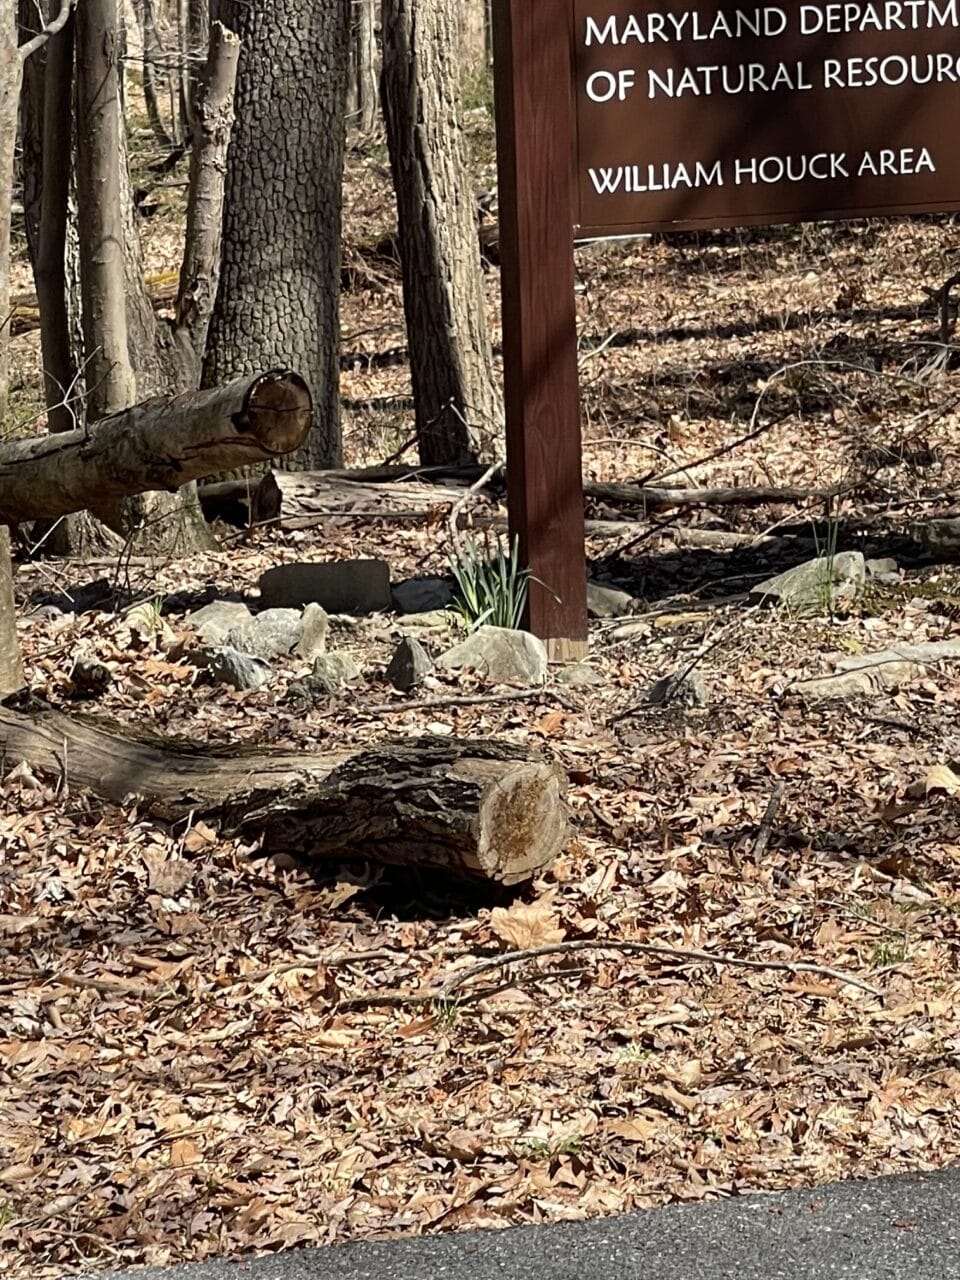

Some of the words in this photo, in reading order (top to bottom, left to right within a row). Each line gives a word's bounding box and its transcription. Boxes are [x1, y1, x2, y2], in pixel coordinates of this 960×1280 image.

[584, 6, 788, 47] MARYLAND
[585, 68, 636, 104] OF
[647, 60, 813, 100] NATURAL
[588, 160, 724, 195] WILLIAM
[733, 152, 850, 185] HOUCK
[857, 146, 937, 176] AREA
